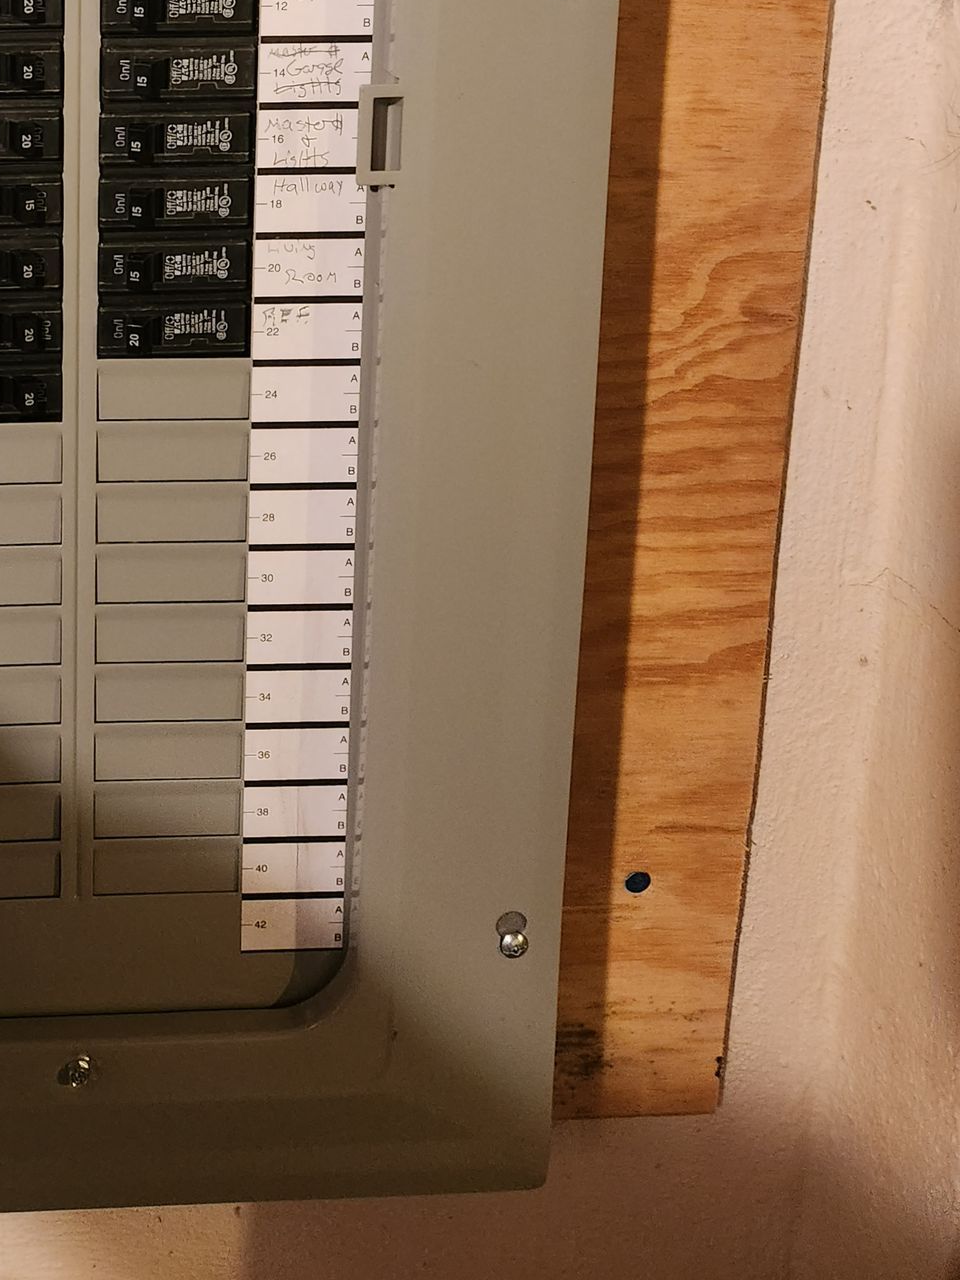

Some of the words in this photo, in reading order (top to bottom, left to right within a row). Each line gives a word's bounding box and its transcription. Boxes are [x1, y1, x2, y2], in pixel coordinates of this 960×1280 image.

[23, 0, 34, 14] 20
[276, 1, 288, 11] 12
[134, 6, 145, 18] 15
[23, 65, 33, 79] 20
[274, 68, 286, 77] 14
[136, 76, 148, 87] 15
[21, 134, 32, 149] 20
[270, 134, 284, 144] 16
[130, 141, 141, 152] 15
[25, 199, 35, 211] 15
[271, 199, 282, 208] 18
[131, 206, 142, 217] 15
[23, 264, 33, 279] 20
[268, 263, 281, 273] 20
[129, 271, 140, 282] 15
[24, 328, 34, 342] 20
[266, 327, 280, 337] 22
[129, 333, 140, 347] 20
[24, 392, 35, 406] 20
[264, 388, 278, 400] 24
[263, 451, 277, 461] 26
[261, 512, 275, 523] 28
[261, 573, 274, 583] 30
[259, 633, 273, 644] 32
[258, 691, 272, 702] 34
[258, 750, 271, 759] 36
[256, 807, 269, 816] 38
[255, 864, 268, 873] 40
[254, 920, 267, 929] 42
